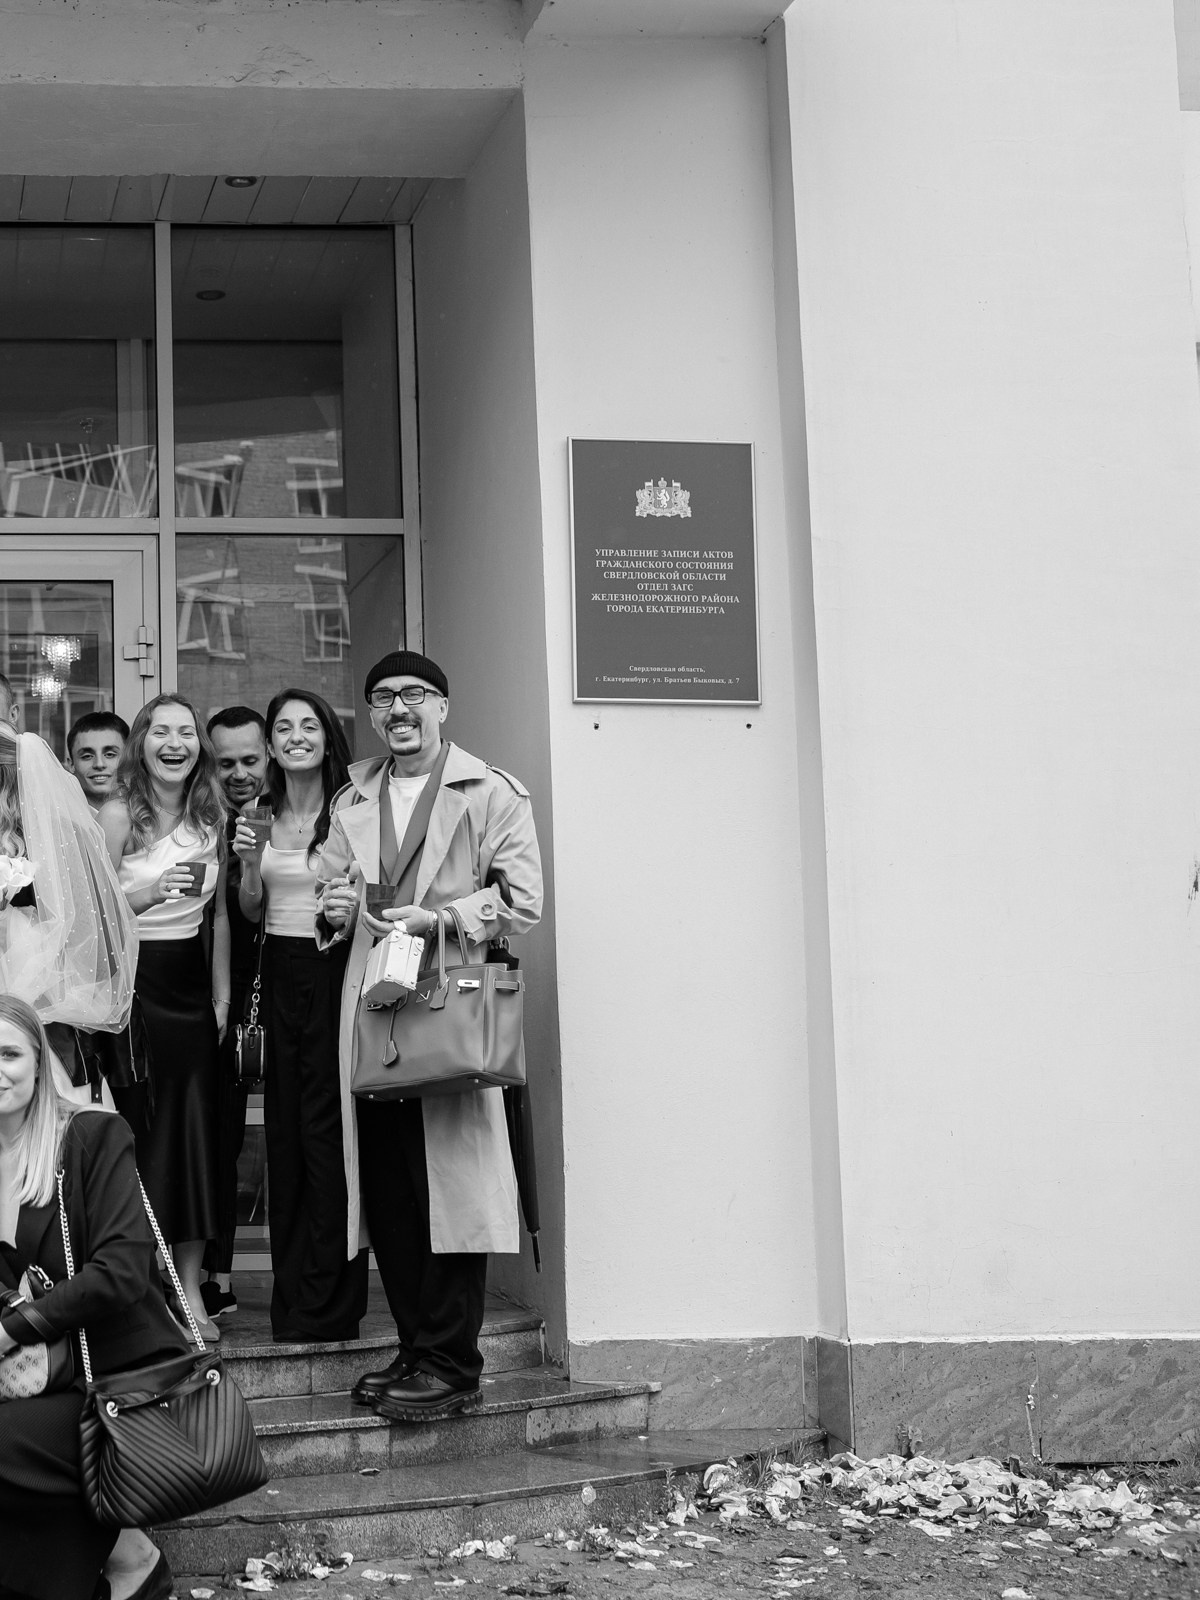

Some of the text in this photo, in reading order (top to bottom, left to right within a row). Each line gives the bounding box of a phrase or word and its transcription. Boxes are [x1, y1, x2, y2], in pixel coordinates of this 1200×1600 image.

[595, 548, 734, 559] УПРАВЛЕНИЕ ЗАПИСИ АКТОВ
[595, 559, 734, 570] ГРАЖДАНСКОГО СОСТОЯНИЯ
[603, 570, 727, 581] СВЕРДЛОВСКОЙ ОБЛАСТИ
[636, 582, 694, 592] ОТДЕЛ ЗАГС
[591, 593, 739, 604] ЖЕЛЕЗНОДОРОЖНОГО РАЙОНА
[606, 604, 725, 614] ГОРОДА ЕКАТЕРИНБУРГА
[629, 665, 706, 674] Свердловская область,
[602, 675, 651, 684] Екатеринбург,
[664, 676, 692, 685] Братьев
